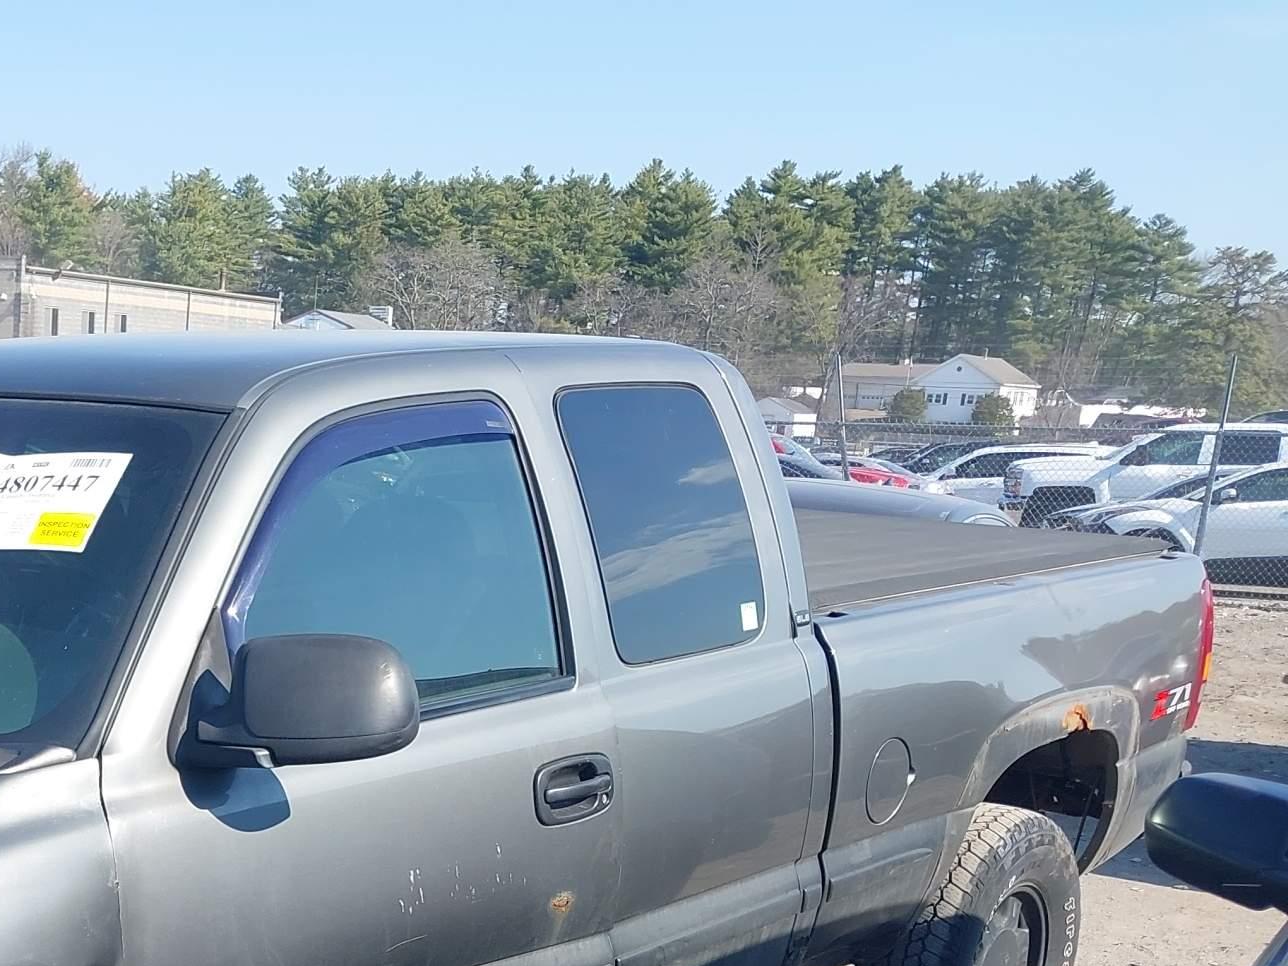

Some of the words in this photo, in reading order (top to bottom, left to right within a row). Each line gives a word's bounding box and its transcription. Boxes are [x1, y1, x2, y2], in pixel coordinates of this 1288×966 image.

[38, 520, 91, 529] INSPECTION
[40, 529, 80, 538] SERVICE
[1150, 682, 1192, 720] Z71
